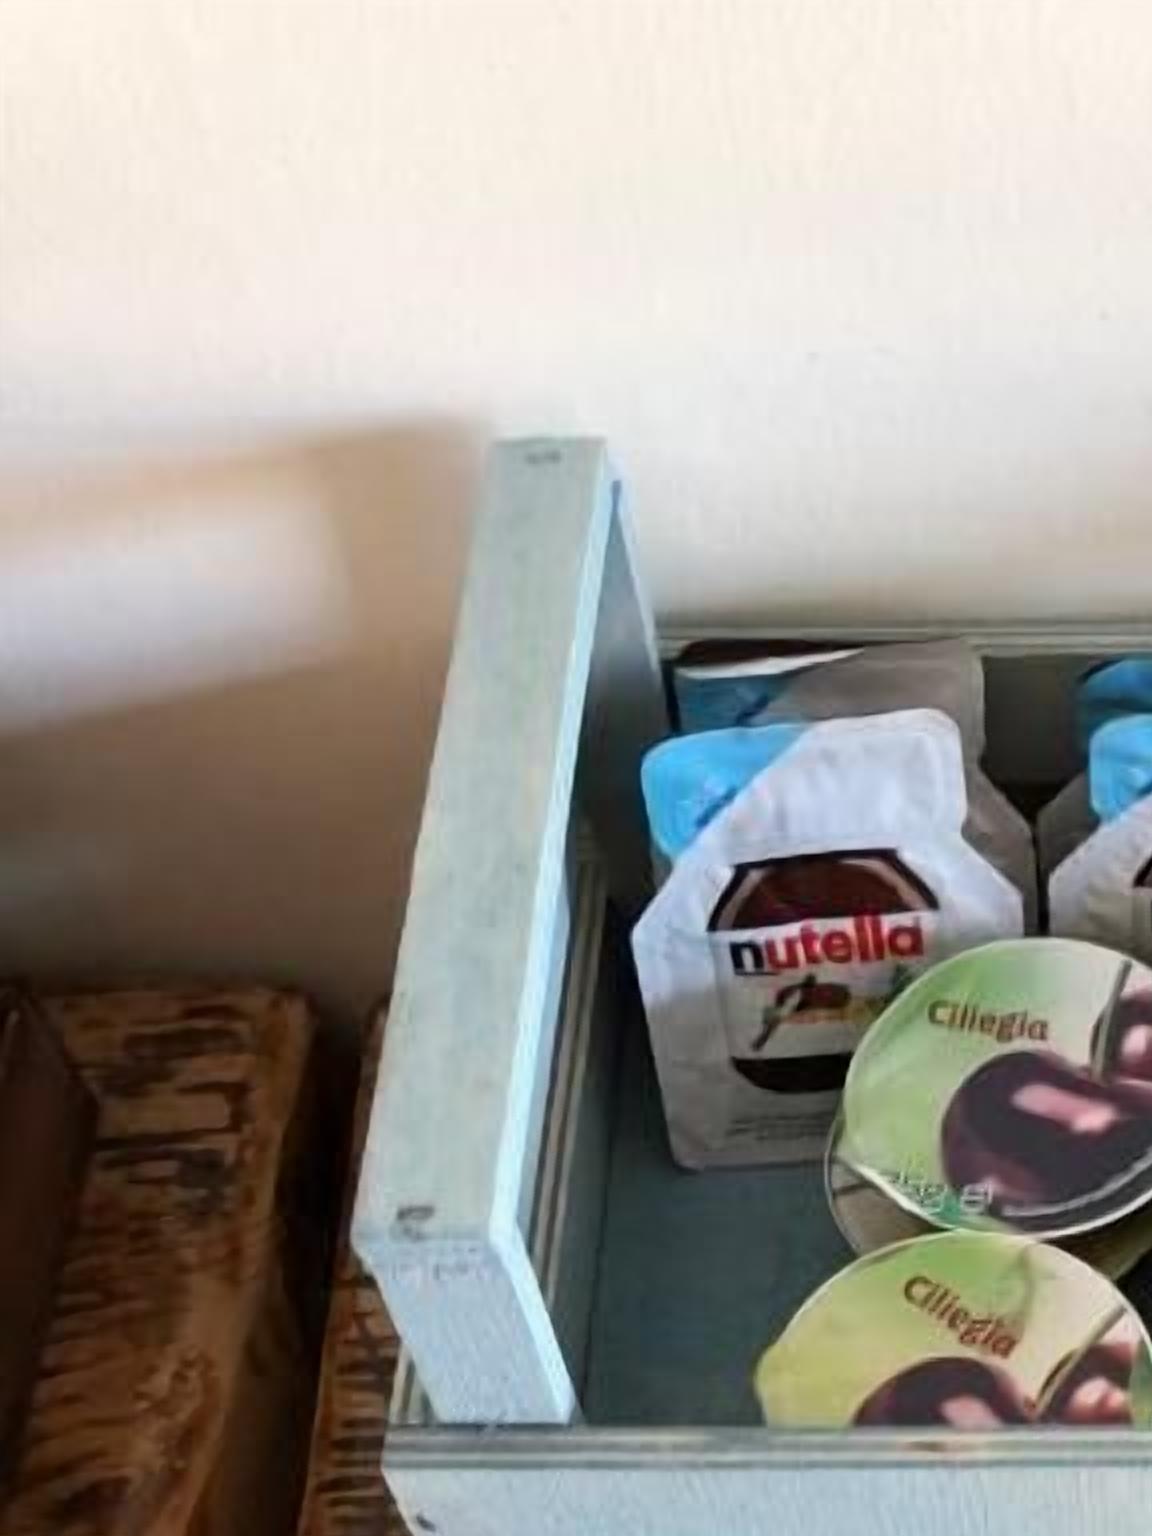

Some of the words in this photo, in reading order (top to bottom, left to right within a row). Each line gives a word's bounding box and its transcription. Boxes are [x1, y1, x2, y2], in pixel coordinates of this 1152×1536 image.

[730, 913, 925, 977] nutella
[928, 1000, 1048, 1043] Ciliegia
[904, 1275, 1017, 1359] Ciliegia
